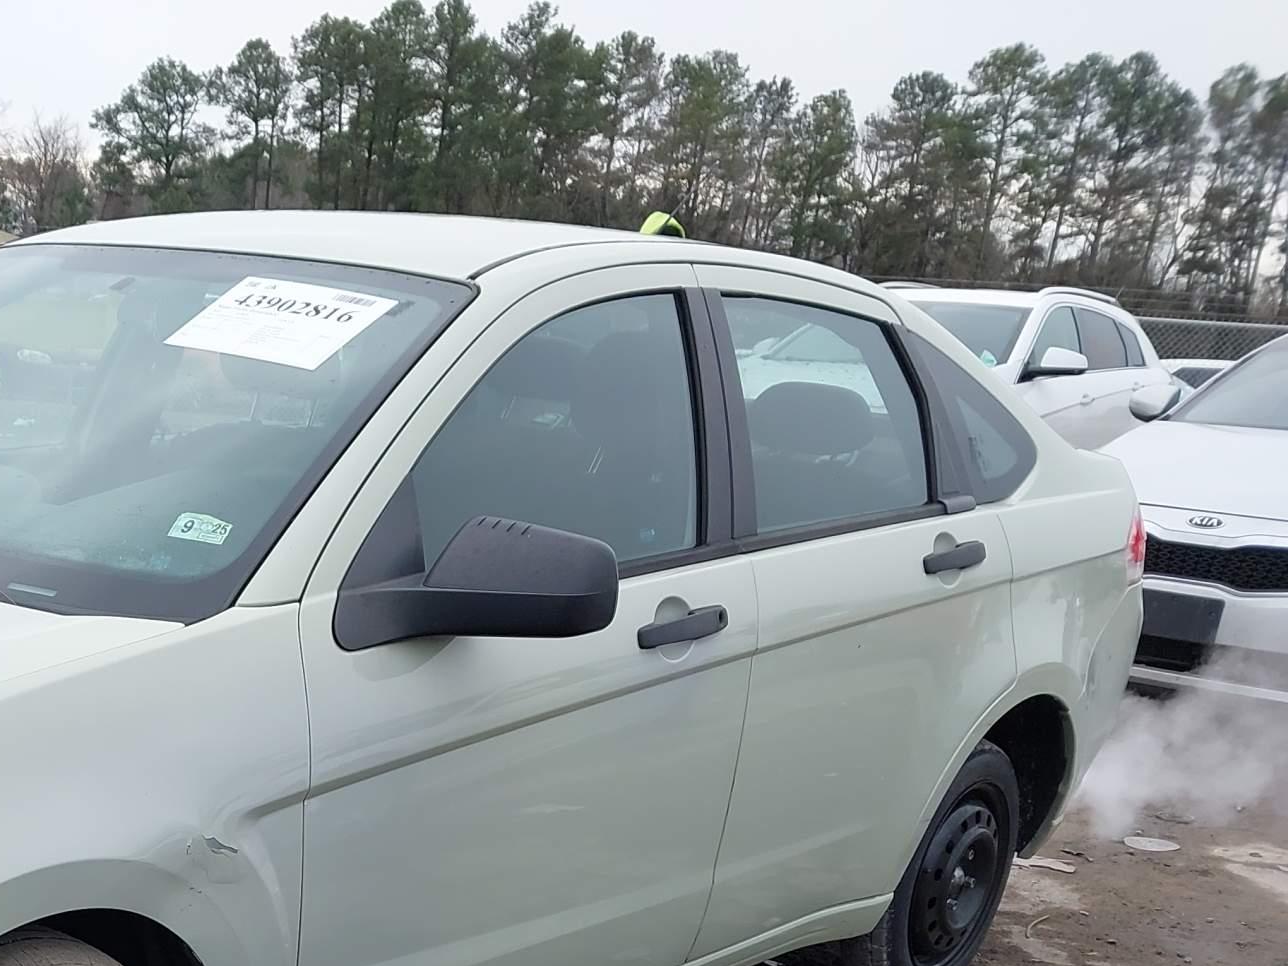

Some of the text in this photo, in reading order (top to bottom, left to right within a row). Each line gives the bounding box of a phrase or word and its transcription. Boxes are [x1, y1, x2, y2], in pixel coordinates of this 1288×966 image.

[234, 293, 360, 323] 43902816
[181, 520, 229, 535] 9 25
[1192, 517, 1218, 526] KIA
